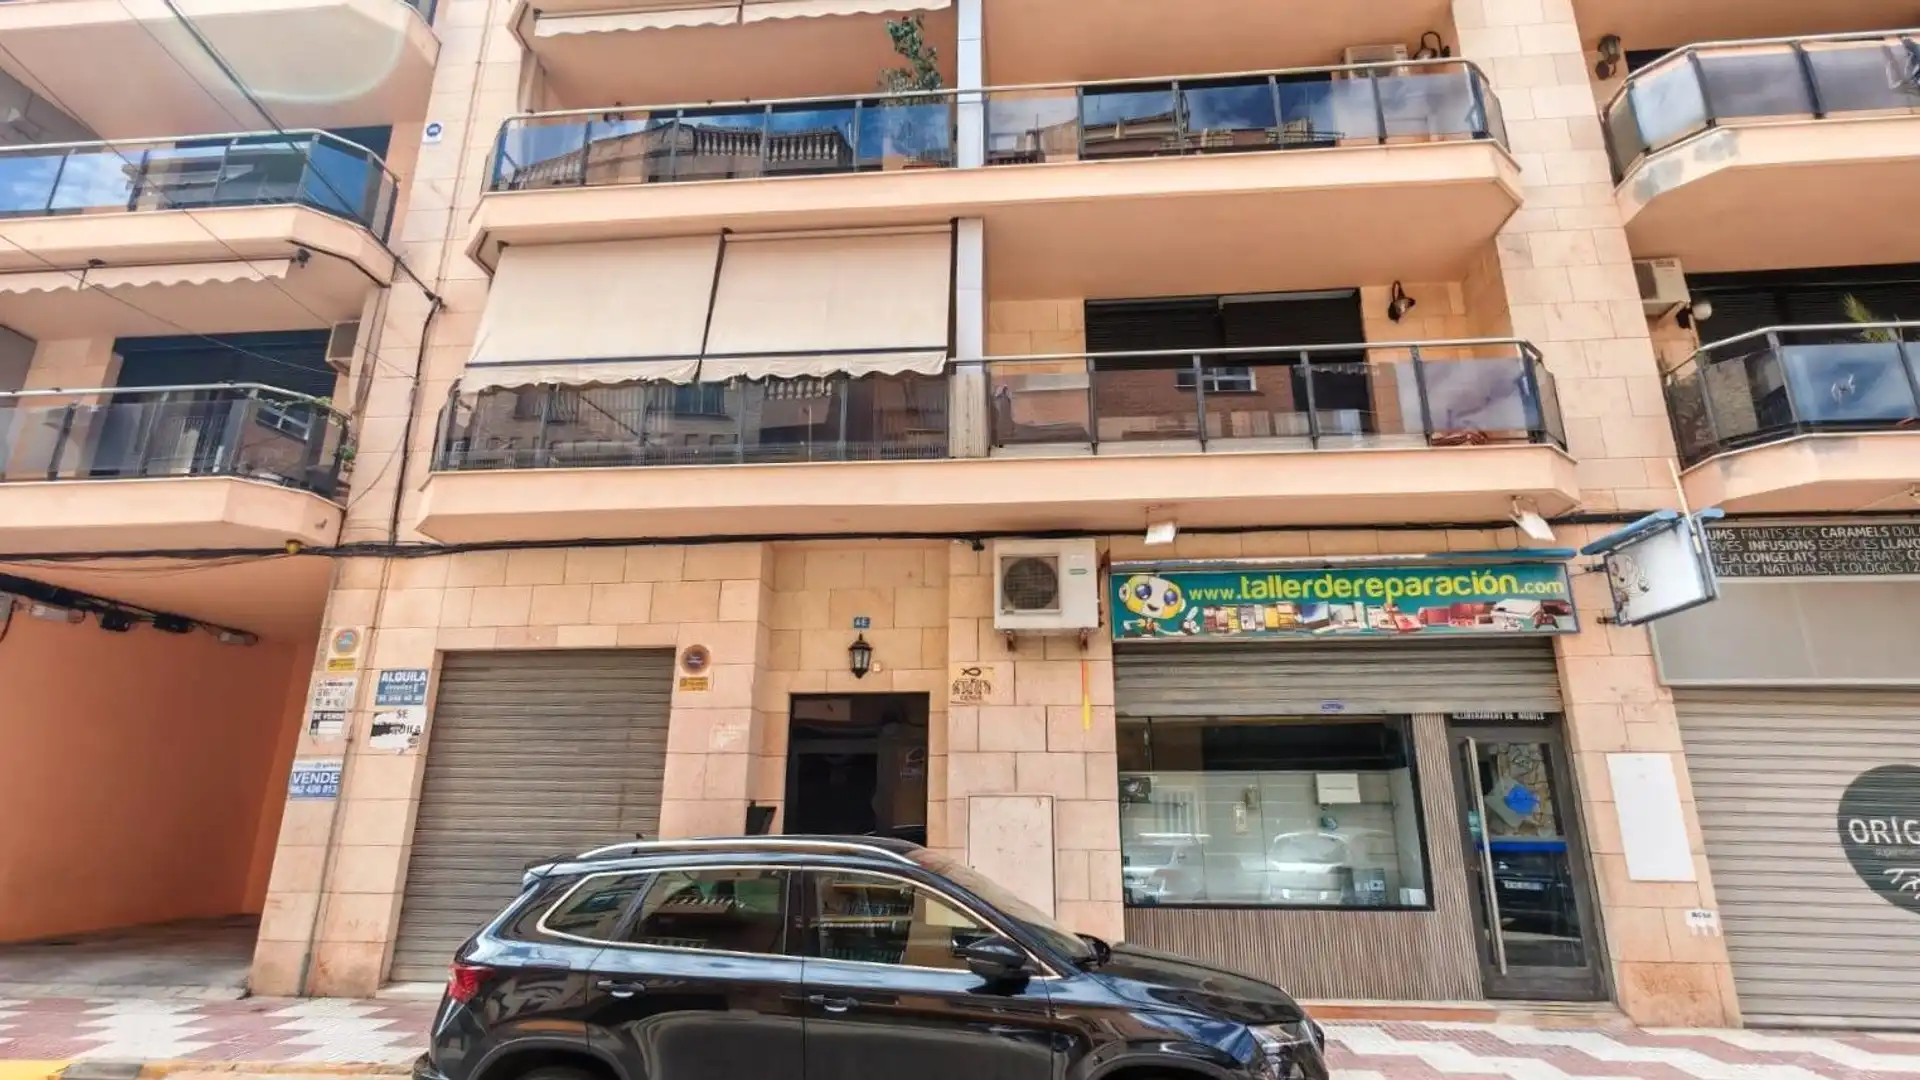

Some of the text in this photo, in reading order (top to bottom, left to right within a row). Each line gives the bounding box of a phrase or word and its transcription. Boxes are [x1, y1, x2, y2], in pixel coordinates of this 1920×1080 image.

[1740, 527, 1785, 540] FRUITS
[1787, 527, 1819, 540] SECS
[1821, 525, 1890, 538] CARAMELS
[1748, 539, 1817, 552] INFUSIONS
[1744, 551, 1818, 564] CONGELATS
[1819, 550, 1905, 563] REFRIGERATS
[293, 771, 341, 784] VENDE
